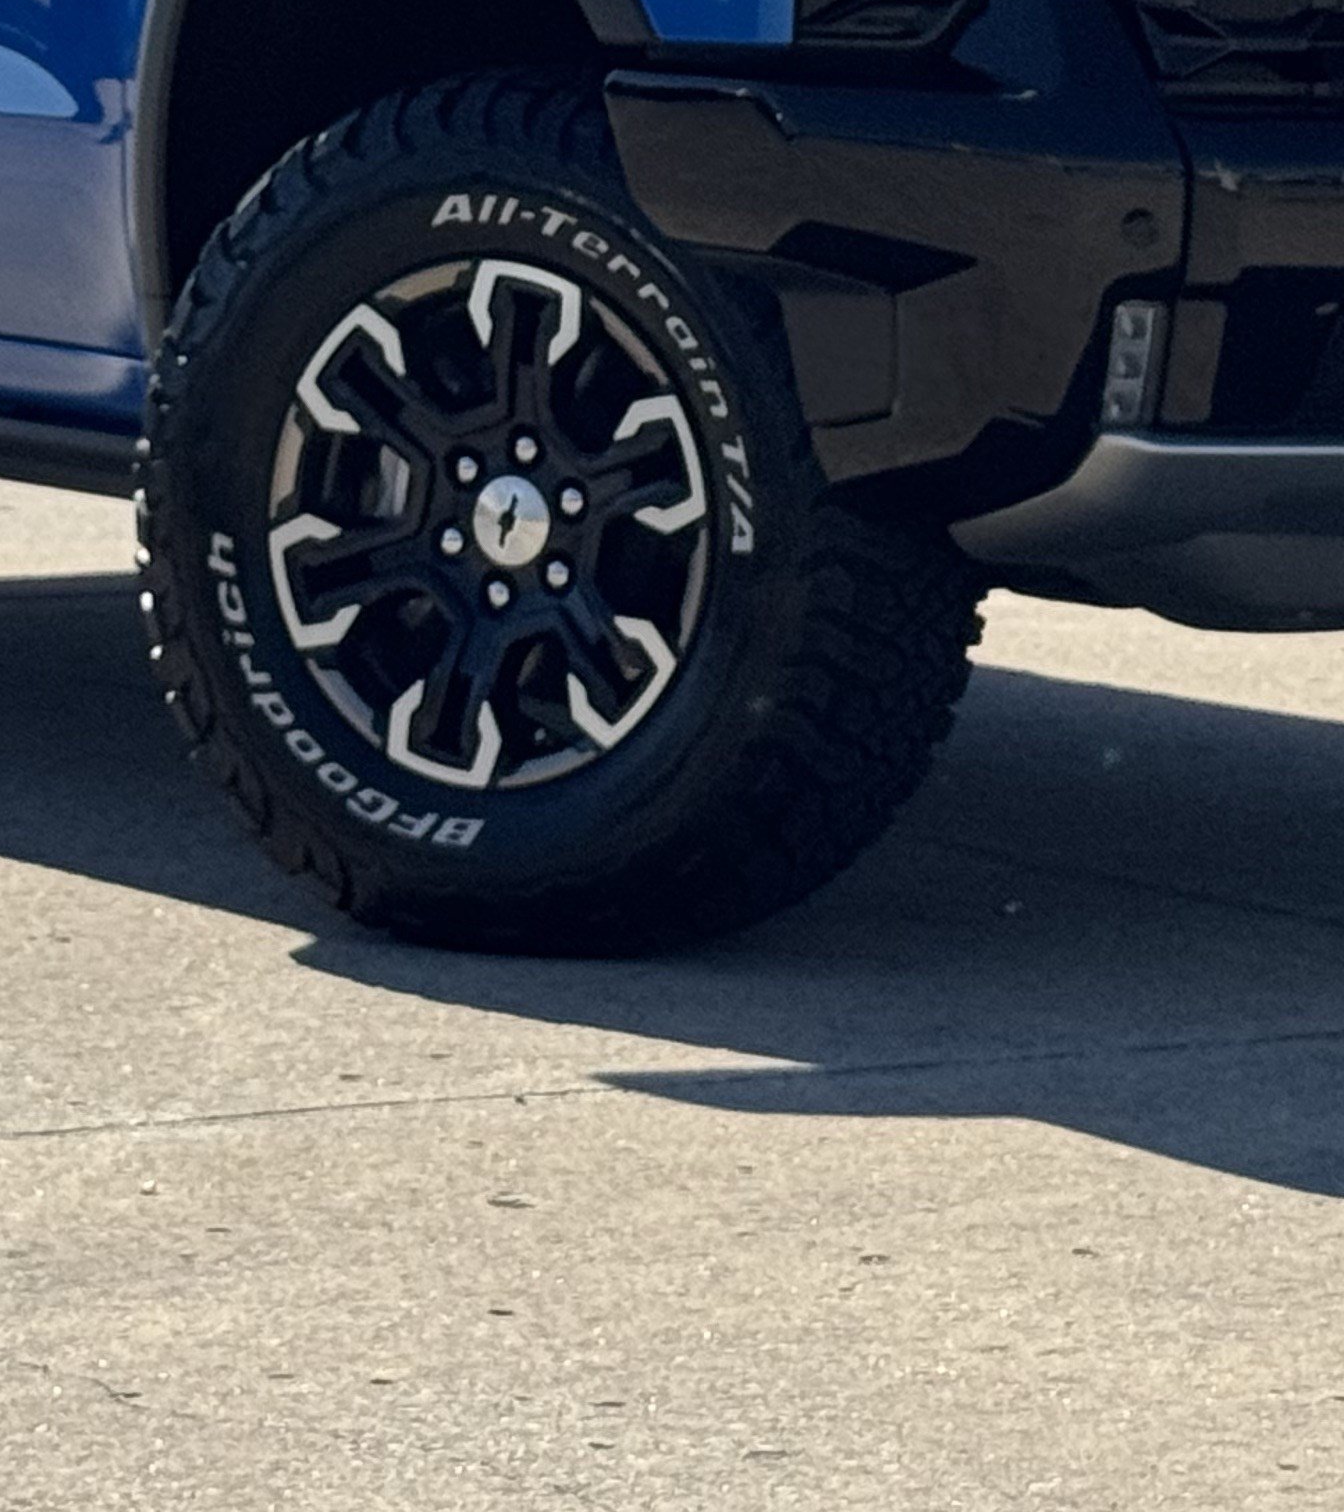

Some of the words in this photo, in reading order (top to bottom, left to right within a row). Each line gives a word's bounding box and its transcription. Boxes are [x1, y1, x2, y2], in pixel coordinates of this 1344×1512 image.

[431, 194, 729, 418] All-Terrain
[721, 434, 754, 553] T/A
[207, 531, 486, 847] BFGoodrich
